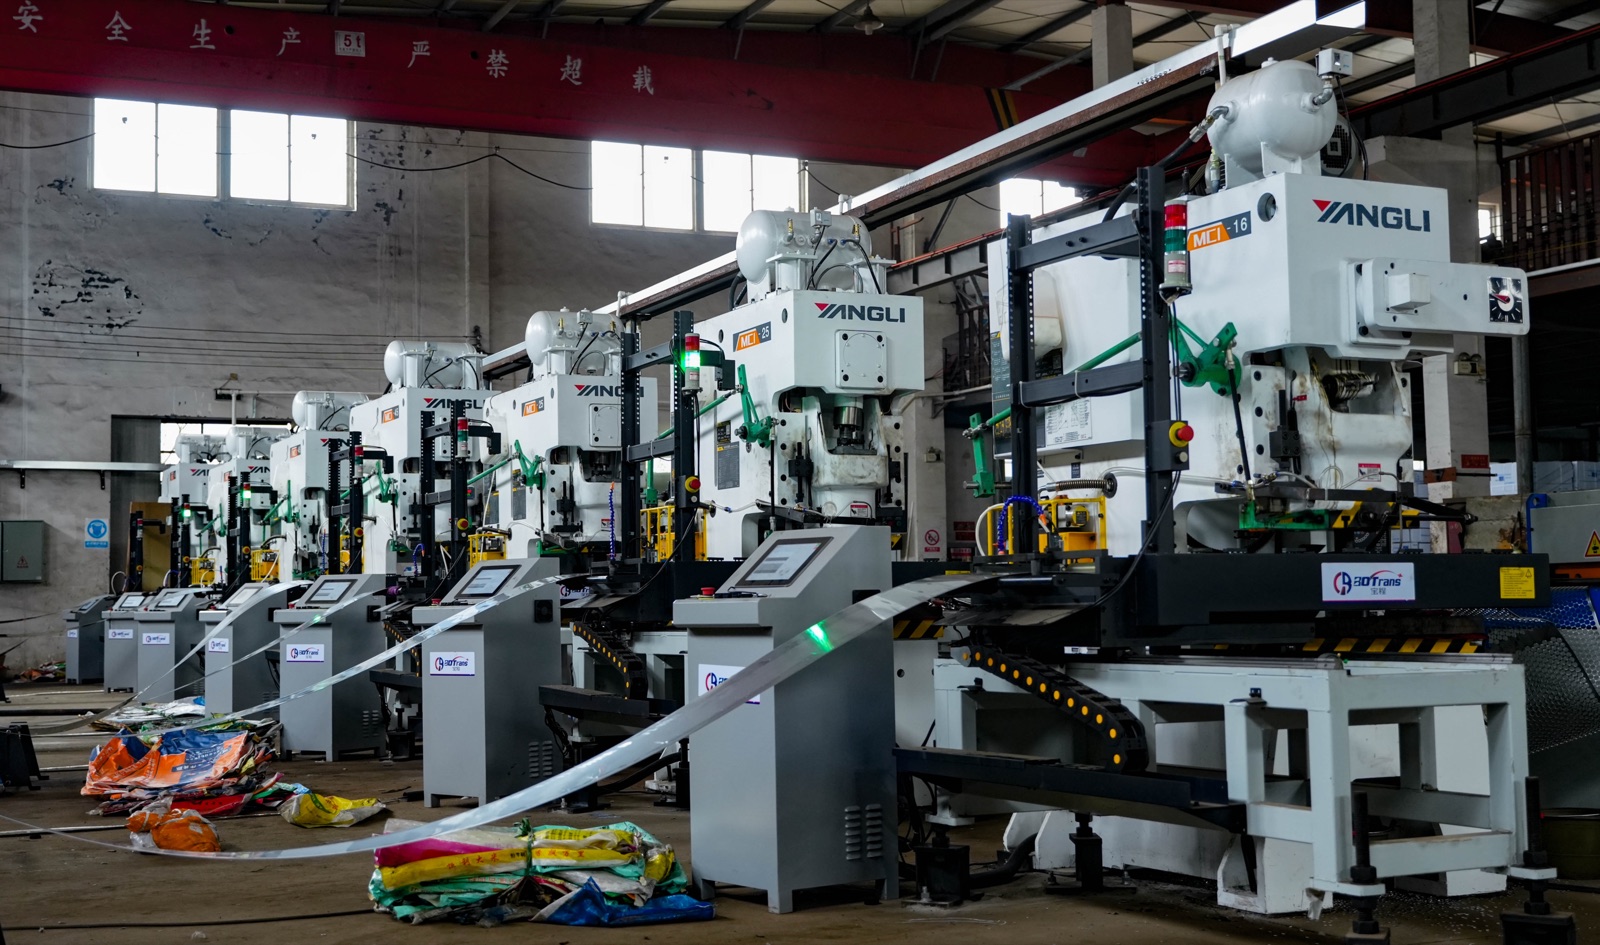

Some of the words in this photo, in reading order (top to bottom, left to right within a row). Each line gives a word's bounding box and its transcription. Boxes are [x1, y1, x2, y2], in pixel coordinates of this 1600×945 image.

[1312, 199, 1431, 232] YANGLI
[814, 303, 906, 323] YANGLI
[574, 385, 645, 397] YANI
